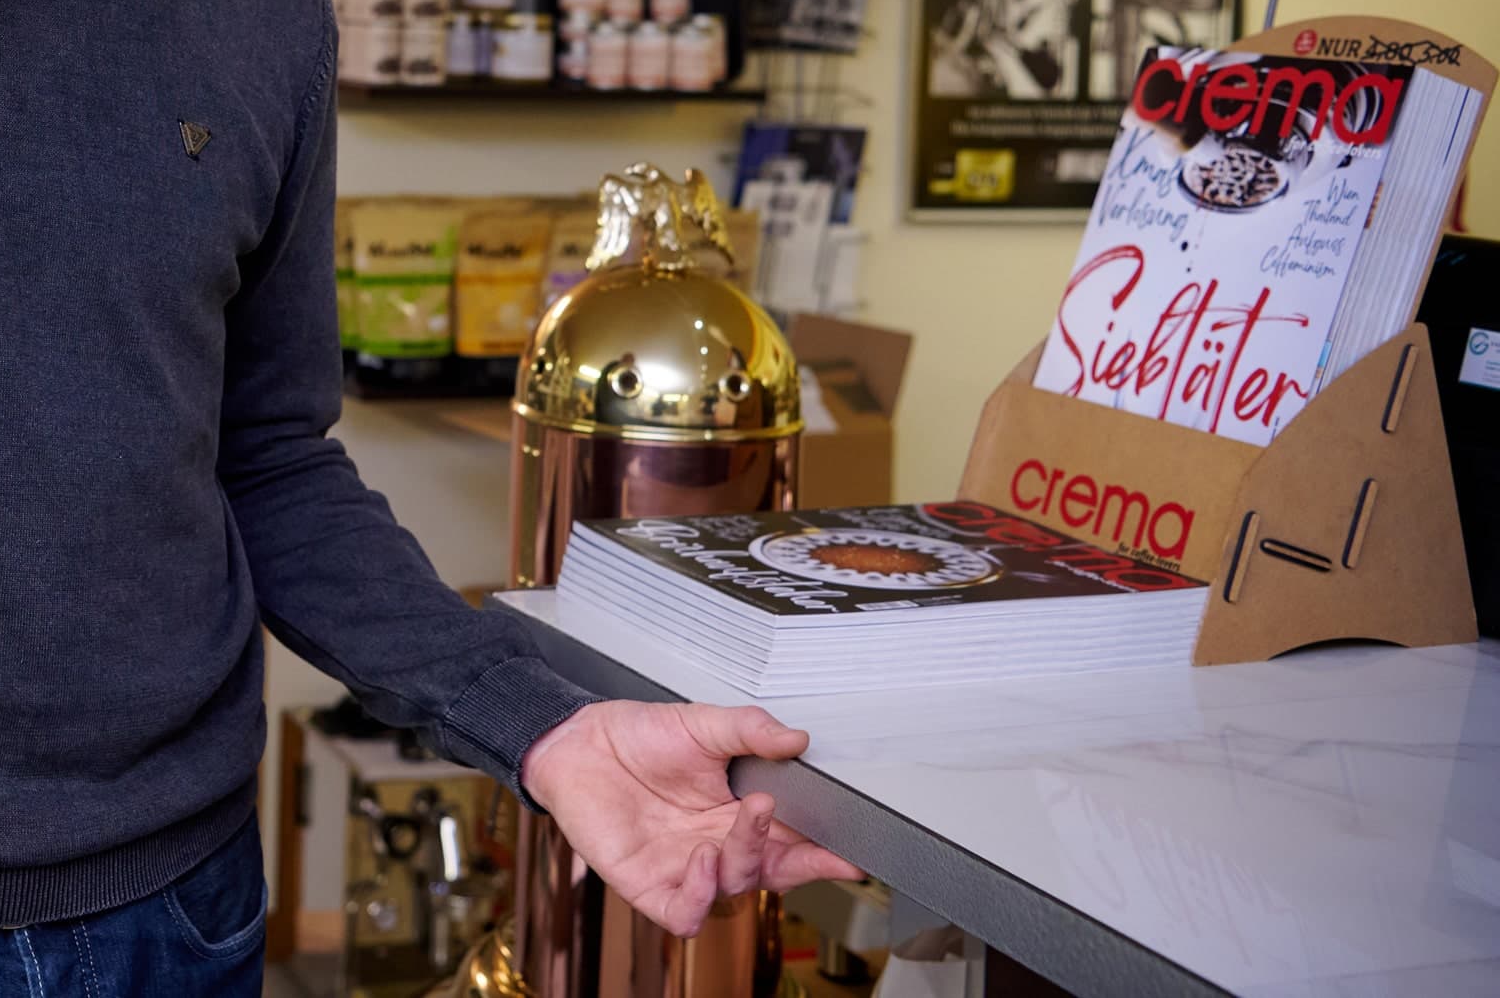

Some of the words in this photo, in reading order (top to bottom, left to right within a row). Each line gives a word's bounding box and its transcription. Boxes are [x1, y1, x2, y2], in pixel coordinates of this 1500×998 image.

[1316, 37, 1362, 58] NUR
[1131, 58, 1404, 146] crema
[1304, 199, 1358, 227] Thailand
[1327, 175, 1359, 204] Wien
[1058, 244, 1310, 435] Siebtäter
[921, 501, 1207, 592] crema
[1011, 459, 1195, 561] crema
